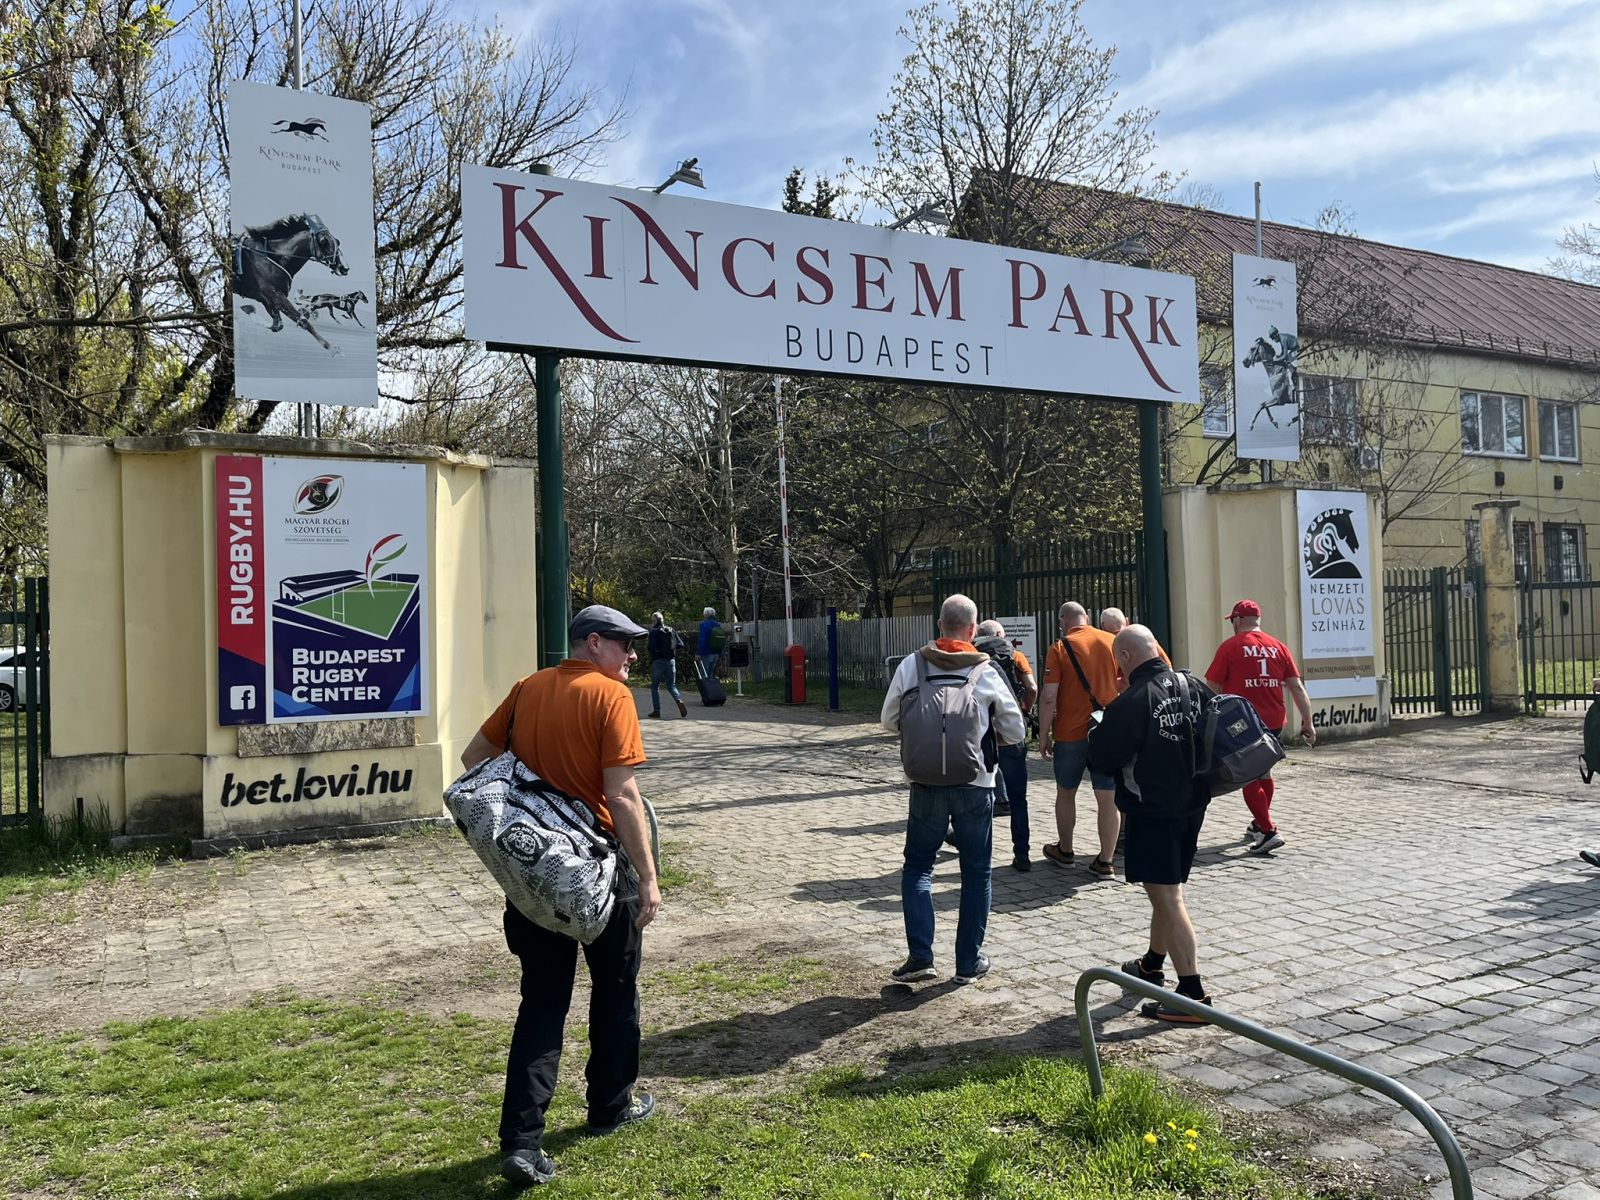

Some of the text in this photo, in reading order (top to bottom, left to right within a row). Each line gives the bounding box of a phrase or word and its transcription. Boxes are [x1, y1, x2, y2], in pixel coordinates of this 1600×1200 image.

[259, 146, 341, 172] KINCSEM PARK
[281, 163, 321, 175] BUDAPEST
[493, 182, 1182, 394] KINCSEM PARK
[786, 324, 994, 376] BUDAPEST
[284, 517, 321, 525] MAGYAR
[228, 474, 254, 625] RUGBY.HU
[1310, 583, 1365, 595] NEMZETI
[1311, 597, 1365, 616] LOVAS
[1311, 617, 1366, 633] SZÍNHÁZ
[292, 647, 406, 666] BUDAPEST
[1243, 645, 1279, 659] MAY
[292, 667, 368, 685] RUGBY
[1257, 658, 1270, 677] 1
[291, 684, 381, 703] CENTER
[1152, 703, 1164, 719] OLD
[1311, 702, 1378, 729] et.lovi.hu
[220, 762, 413, 808] bet.lovi.hu
